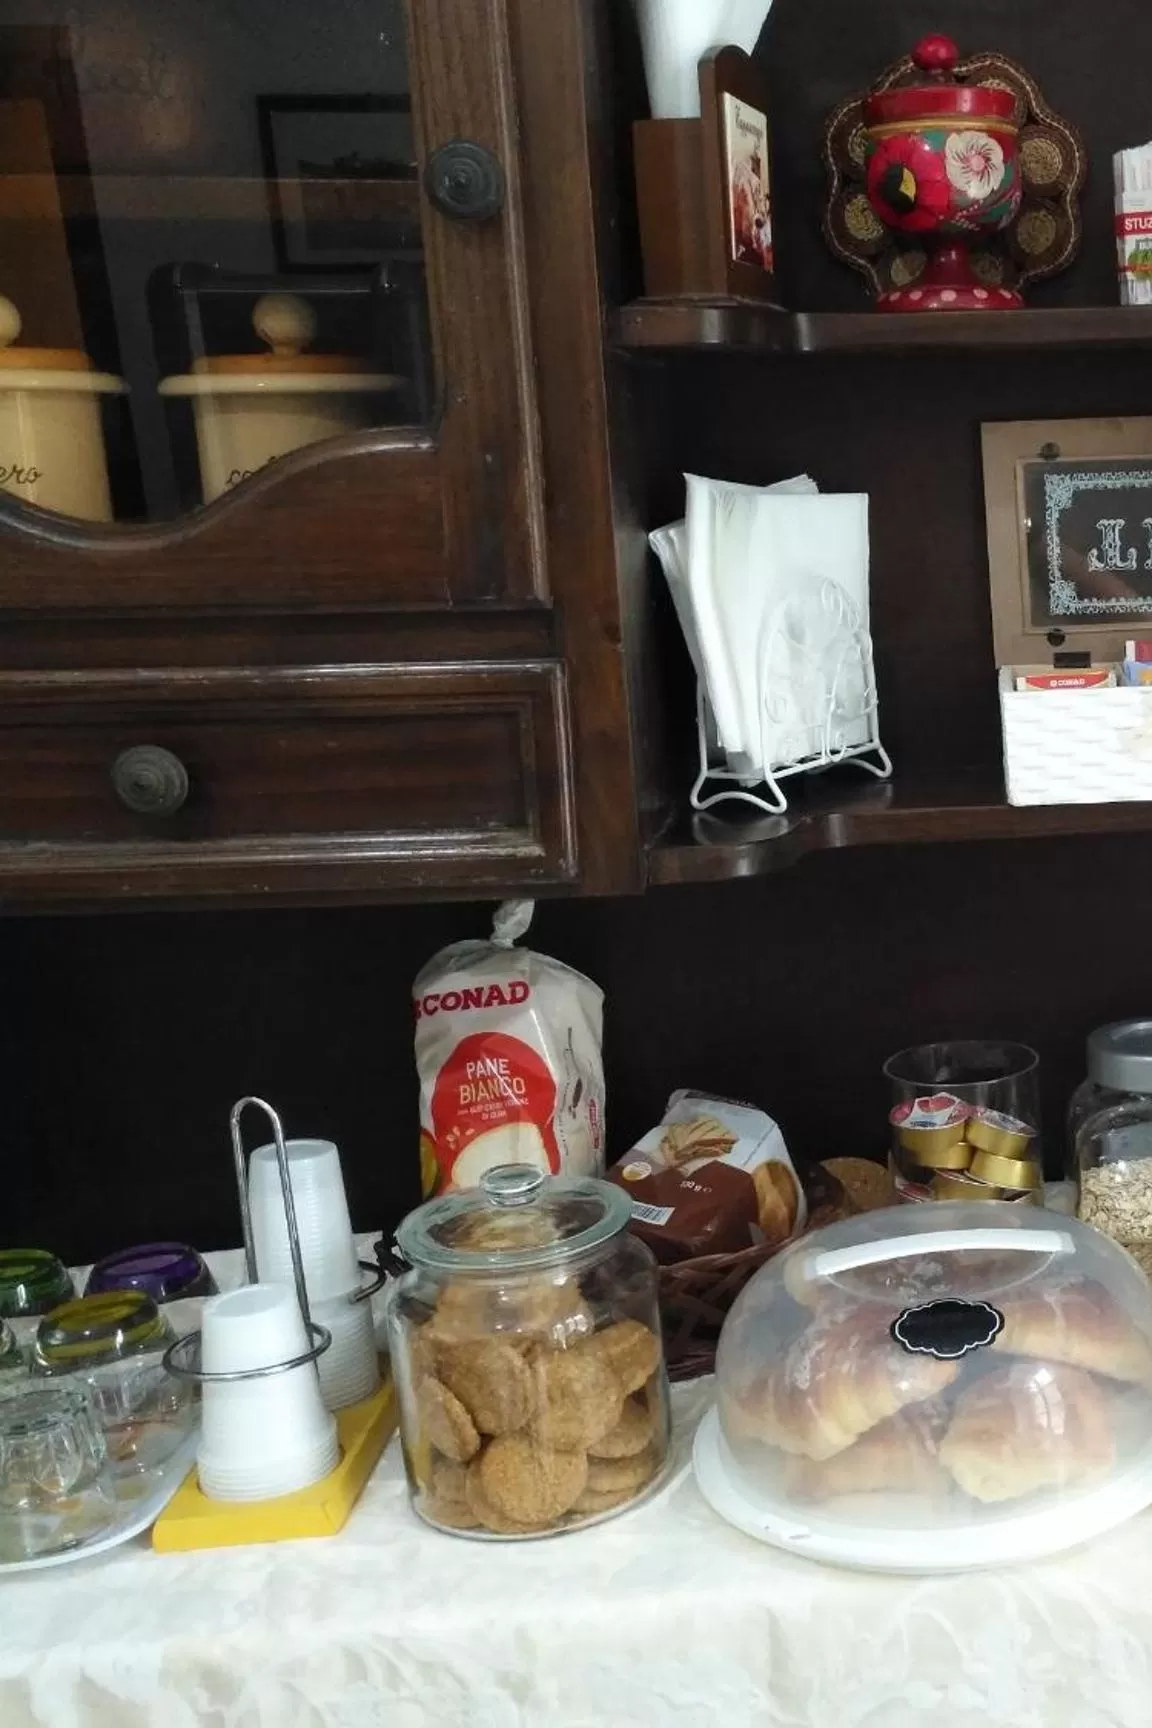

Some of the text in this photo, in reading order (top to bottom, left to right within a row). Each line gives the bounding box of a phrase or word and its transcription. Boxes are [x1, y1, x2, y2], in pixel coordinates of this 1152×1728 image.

[422, 980, 530, 1017] CONAD
[466, 1058, 511, 1080] PANE
[459, 1076, 526, 1105] BIANCO
